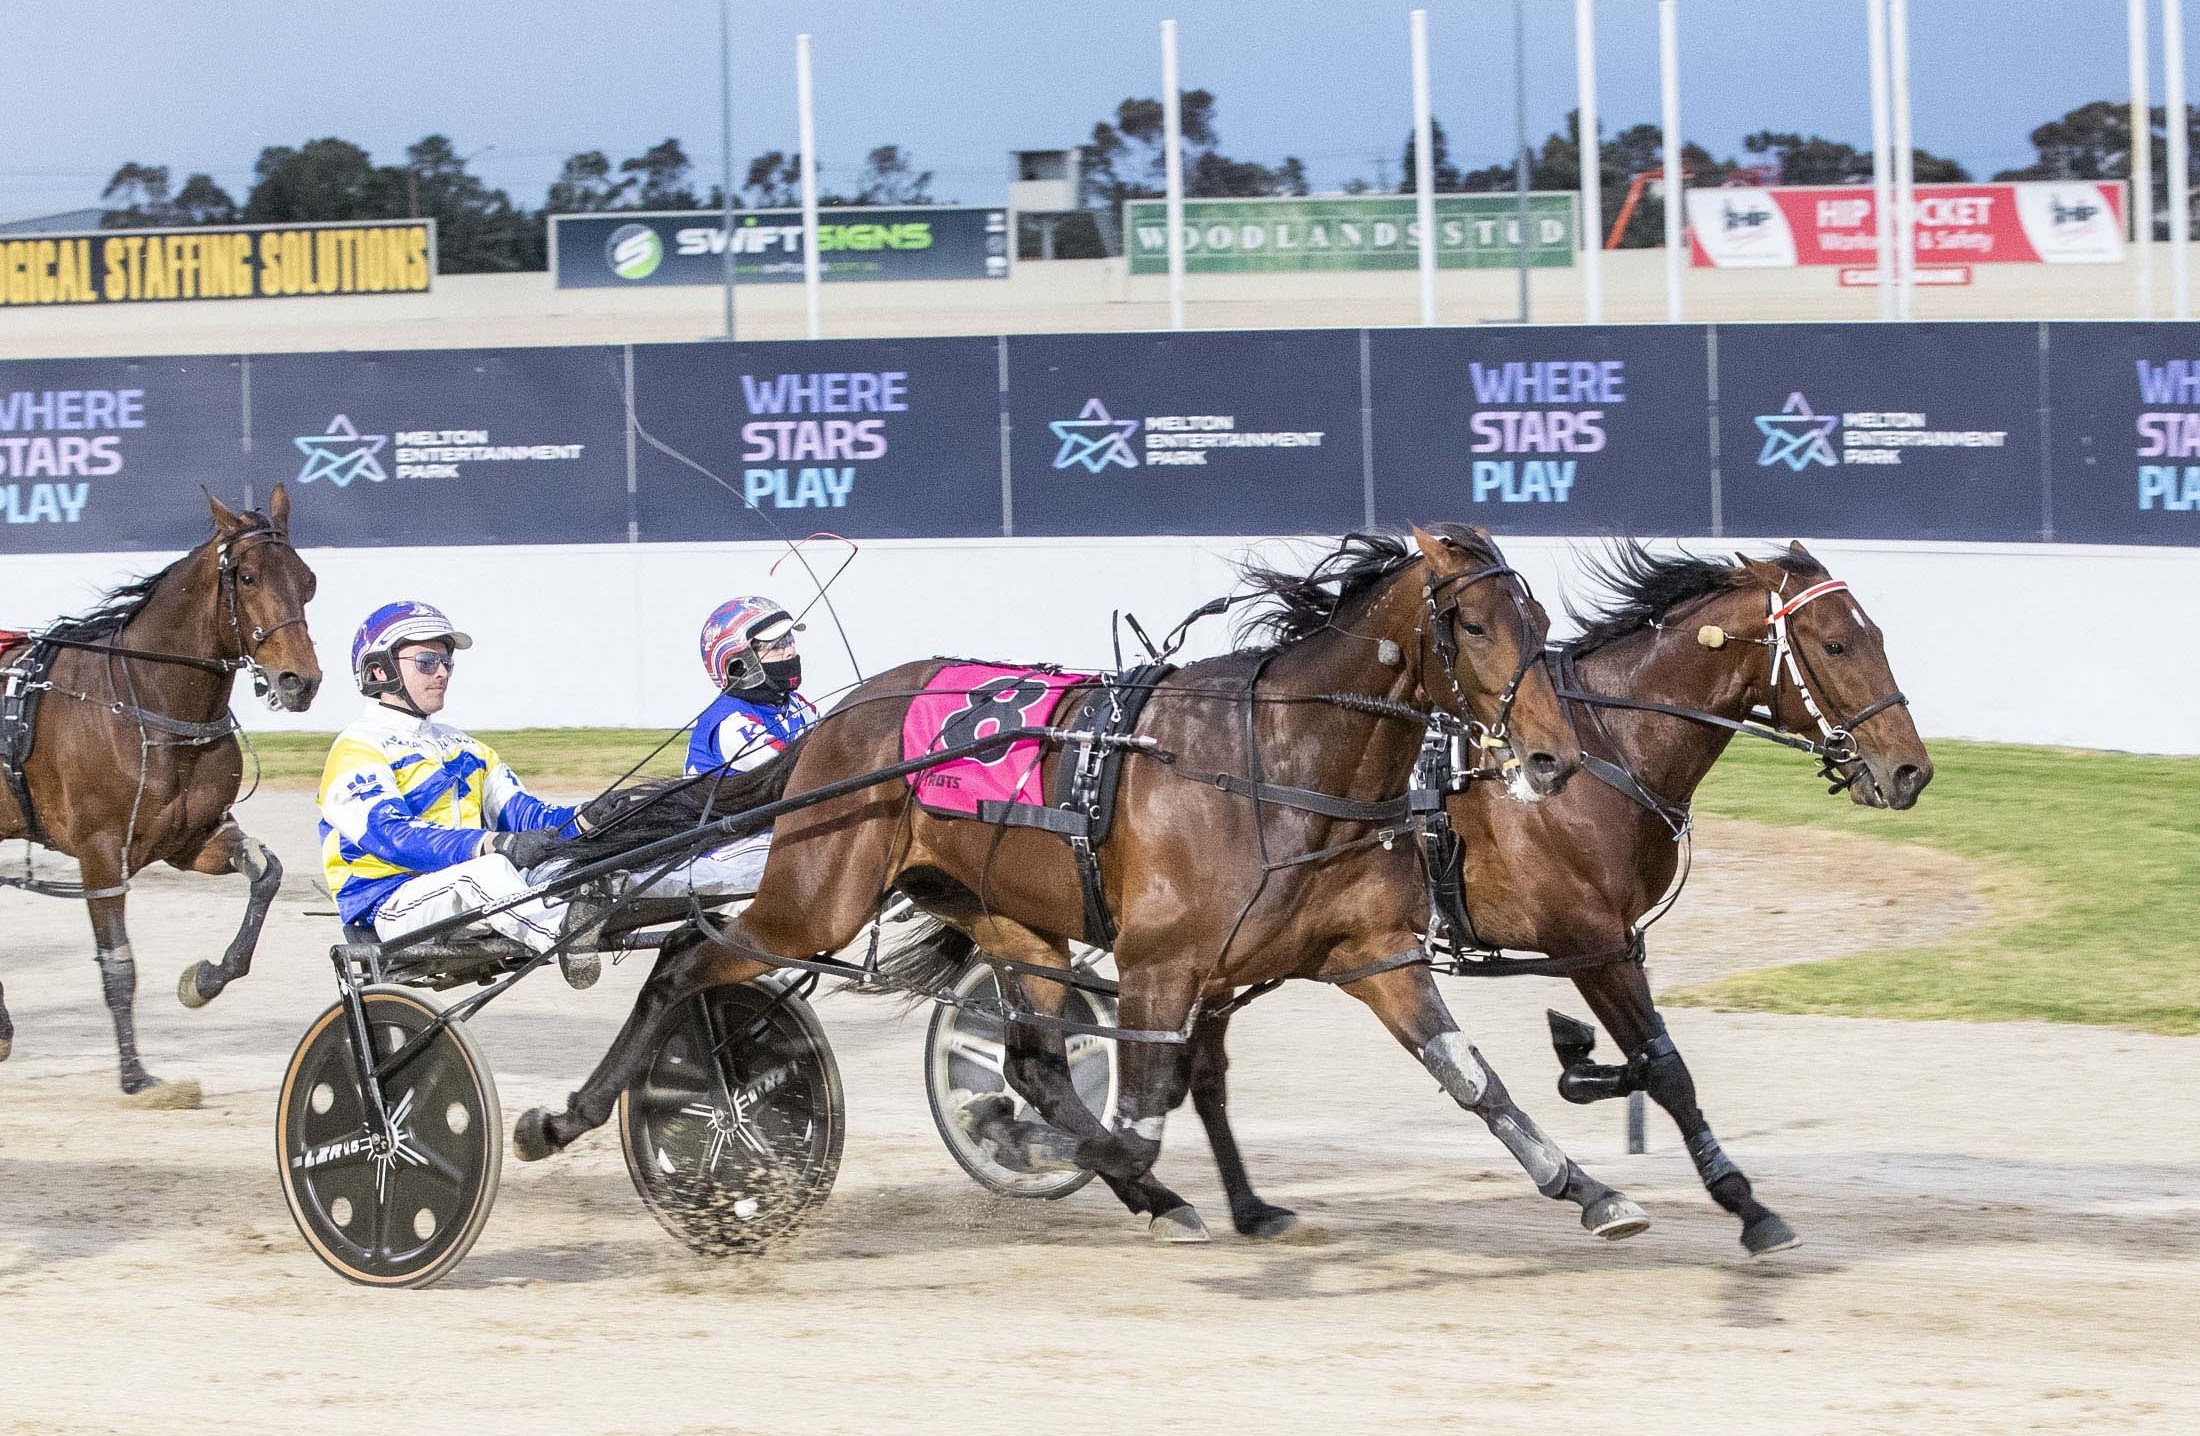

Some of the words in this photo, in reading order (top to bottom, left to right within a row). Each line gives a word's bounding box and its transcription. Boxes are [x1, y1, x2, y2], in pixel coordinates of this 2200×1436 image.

[1817, 199, 1871, 227] HIP
[1896, 197, 1995, 226] CKET
[104, 232, 253, 301] STAFFING
[259, 226, 429, 296] SOLUTIONS
[741, 371, 908, 414] WHERE
[1469, 360, 1625, 403] WHERE
[1145, 416, 1234, 430] MELTON
[1470, 411, 1606, 454] STARS
[1843, 412, 1926, 428] MELTON
[395, 430, 488, 446] MELTON
[741, 419, 888, 463] STARS
[1145, 432, 1325, 448] ENTERTAINMENT
[1843, 431, 2008, 447] ENTERTAINMENT
[0, 435, 122, 477] TARS
[395, 444, 585, 463] ENTERTAINMENT
[1146, 450, 1208, 466] PARK
[1843, 449, 1902, 464] PARK
[396, 464, 460, 479] PARK
[1472, 460, 1577, 502] PLAY
[744, 467, 855, 508] PLAY
[940, 675, 1050, 768] 8
